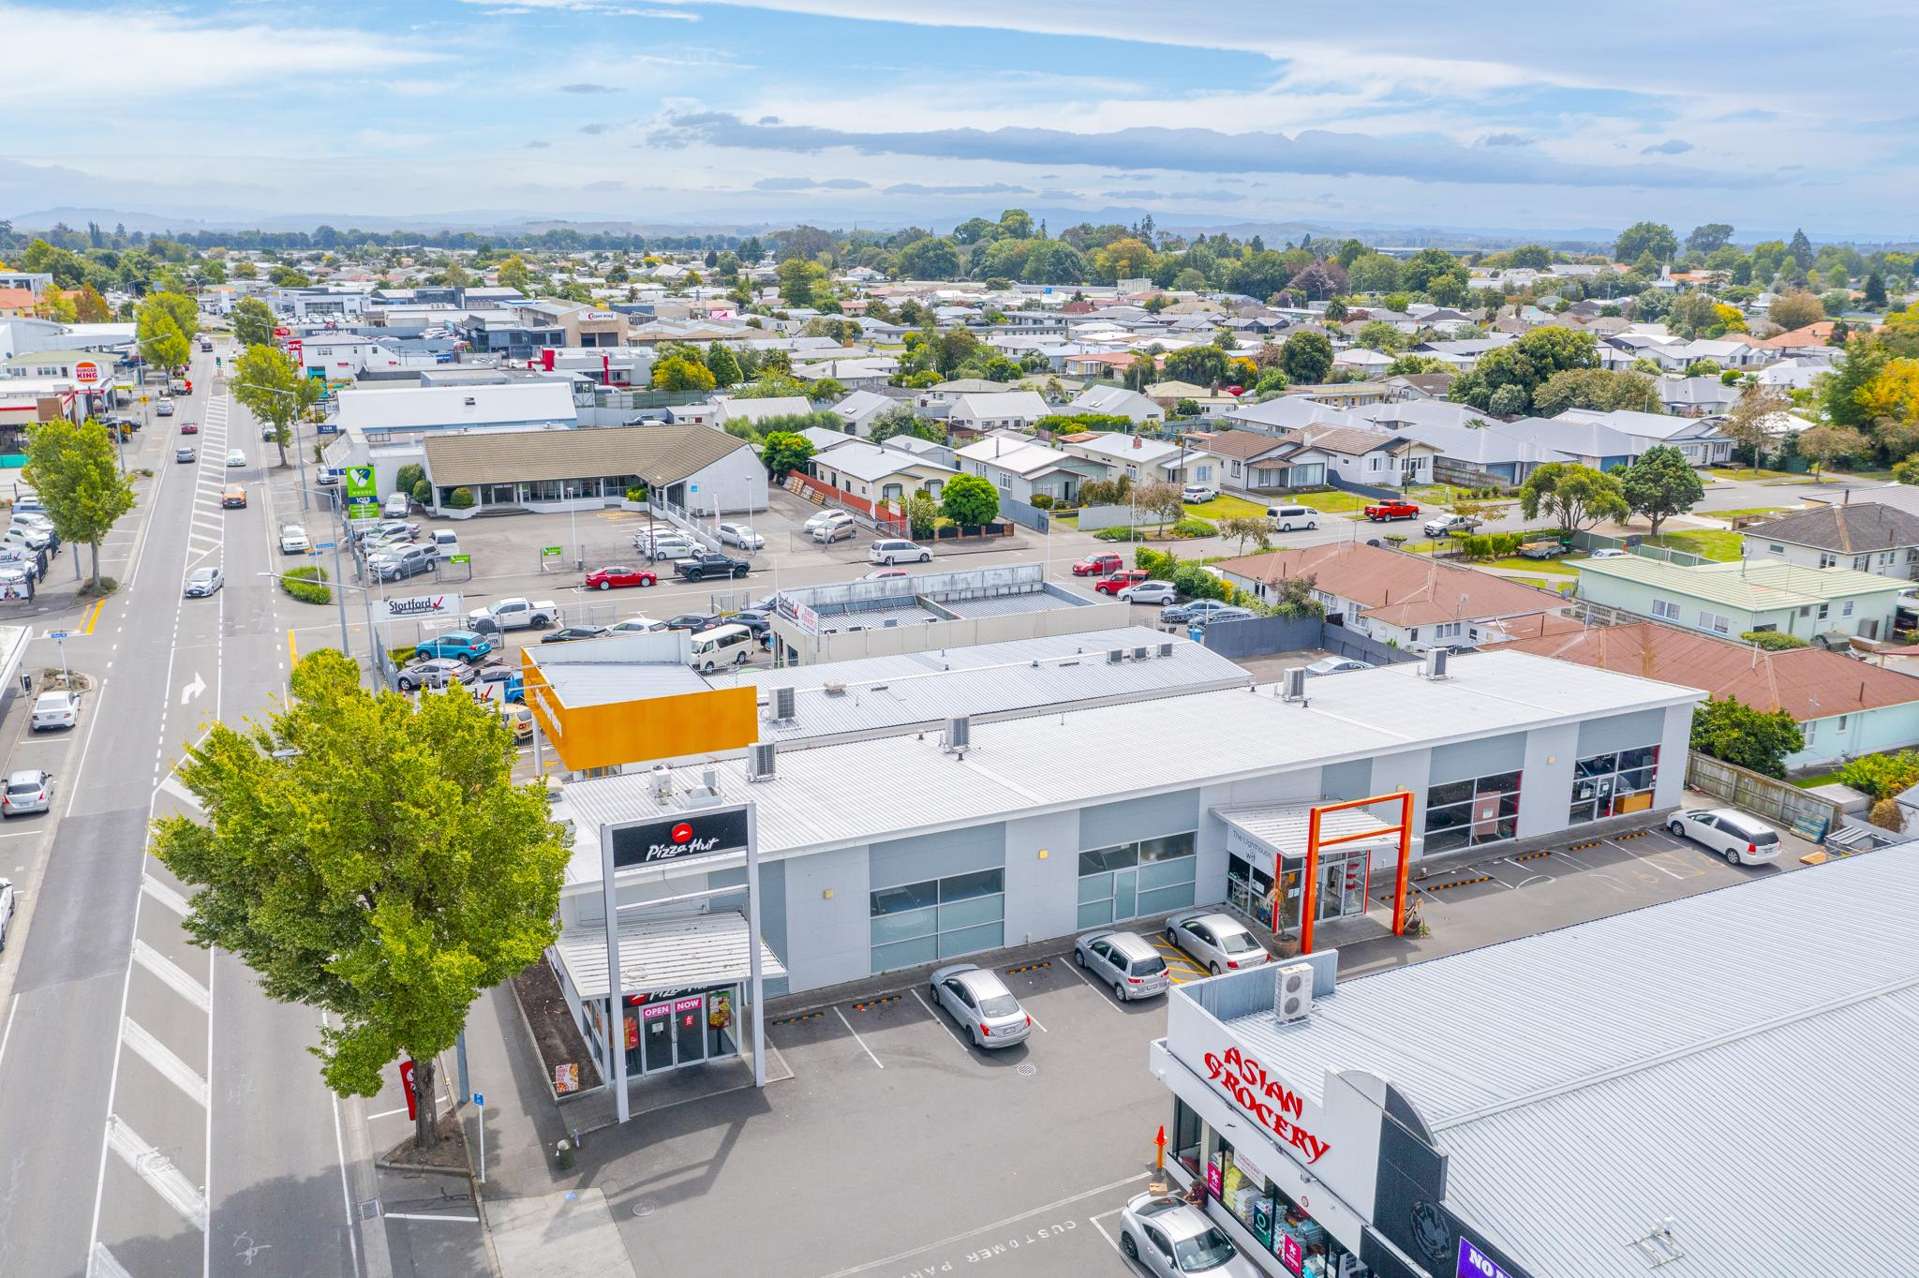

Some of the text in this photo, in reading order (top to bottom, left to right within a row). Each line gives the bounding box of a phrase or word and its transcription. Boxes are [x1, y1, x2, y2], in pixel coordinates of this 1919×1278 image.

[389, 597, 432, 612] Stortford
[646, 837, 720, 861] Pizza Hut
[645, 999, 700, 1017] OPEN NOW
[1224, 1047, 1302, 1120] ASIAN
[1204, 1052, 1330, 1164] GROCERY
[965, 1220, 1077, 1263] CUSTOMER
[1469, 1247, 1494, 1277] NO
